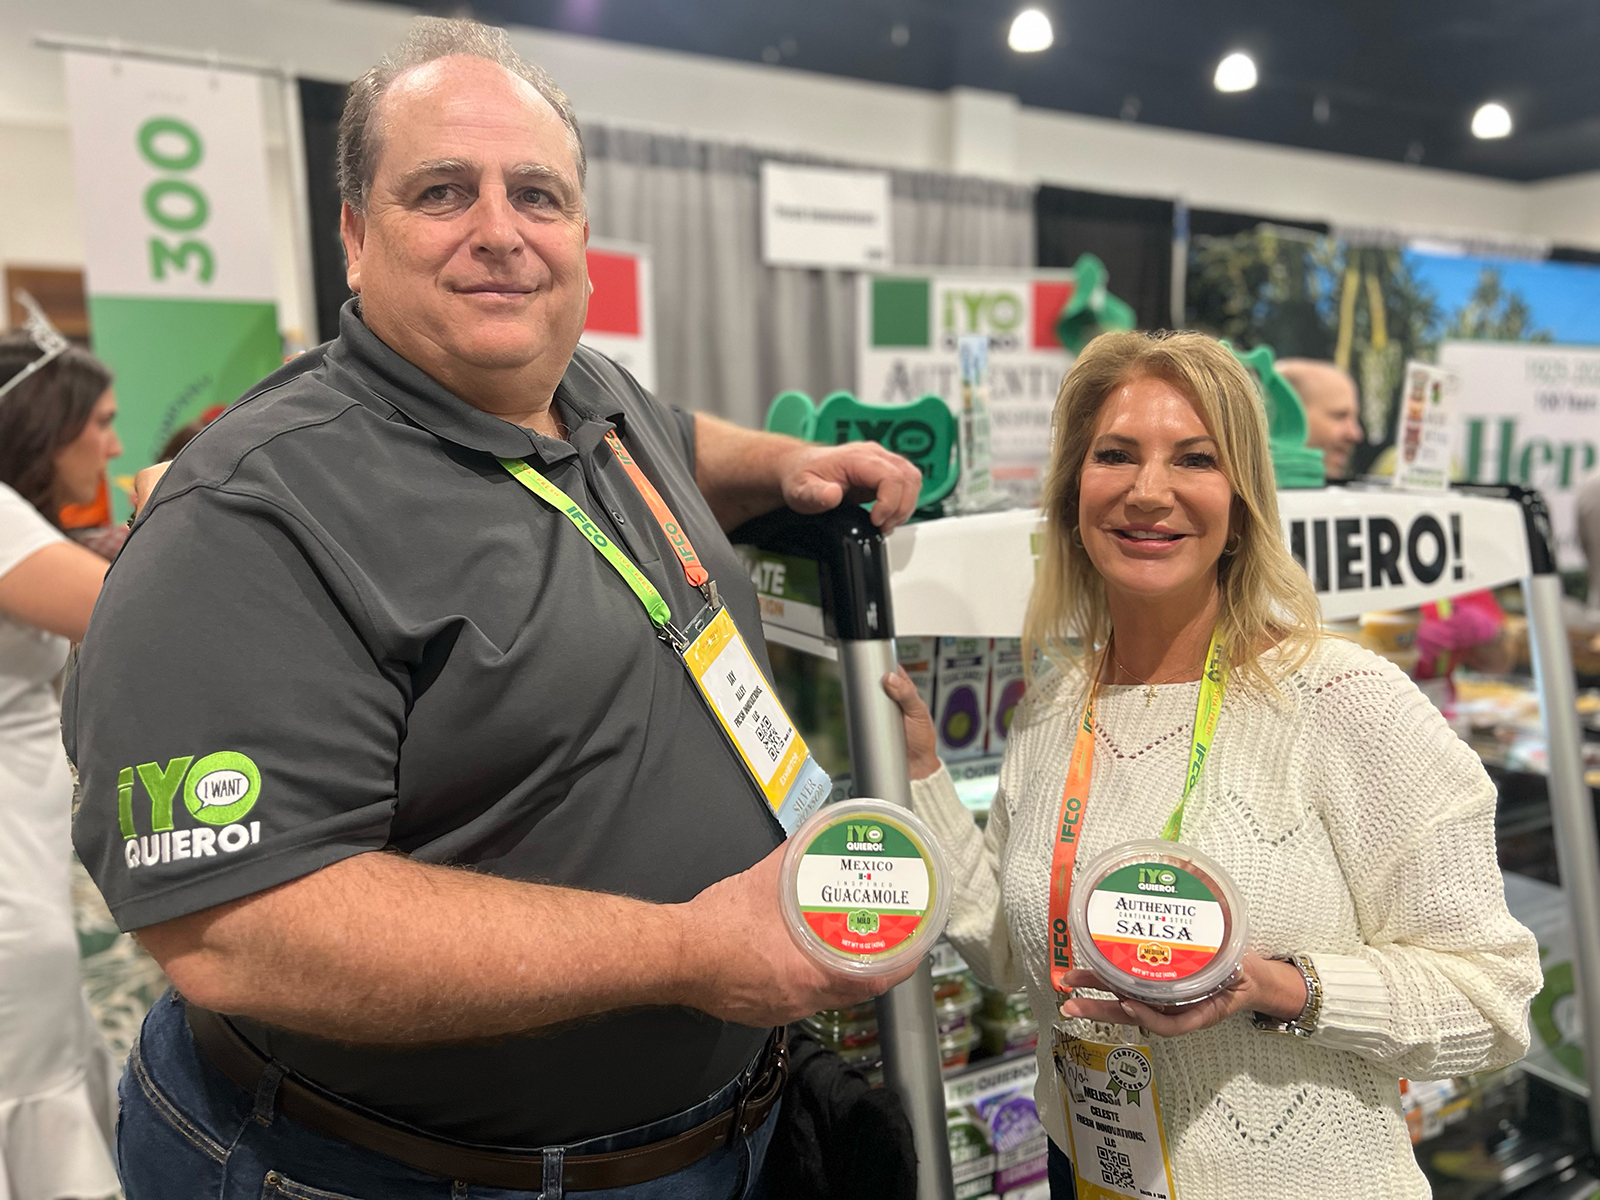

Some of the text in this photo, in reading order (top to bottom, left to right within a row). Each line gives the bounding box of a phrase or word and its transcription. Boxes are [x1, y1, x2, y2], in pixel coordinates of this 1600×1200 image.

[136, 115, 216, 285] 300
[566, 505, 608, 548] IFCO
[665, 522, 696, 562] IFCO
[1290, 512, 1465, 593] IERO!
[615, 552, 656, 596] VIVA FRESH
[1206, 690, 1220, 736] VIVA FRESH
[779, 751, 800, 787] EXHIBITOR
[1189, 742, 1207, 790] IFCO
[211, 778, 242, 798] WANT
[792, 778, 817, 813] SILVER
[1060, 797, 1082, 844] IFCO
[124, 820, 261, 869] QUIERO!
[846, 841, 883, 852] QUIERO!
[840, 858, 894, 872] MEXICO
[821, 885, 910, 905] GUACAMOLE
[836, 880, 894, 888] INSPIRED
[1138, 882, 1176, 893] QUIERO!
[1115, 897, 1196, 917] AUTHENTIC
[1119, 911, 1193, 925] CANTINA STYLE
[856, 916, 871, 925] MILD
[1116, 919, 1194, 942] SALSA
[1052, 918, 1070, 969] IFCO
[1143, 948, 1166, 956] MEDIUM
[1113, 1050, 1149, 1073] CERTIFIED
[1110, 1069, 1144, 1090] SNACKER
[1076, 1112, 1095, 1129] FRESH
[1090, 1105, 1121, 1123] CELESTE
[1103, 1136, 1117, 1149] LLC
